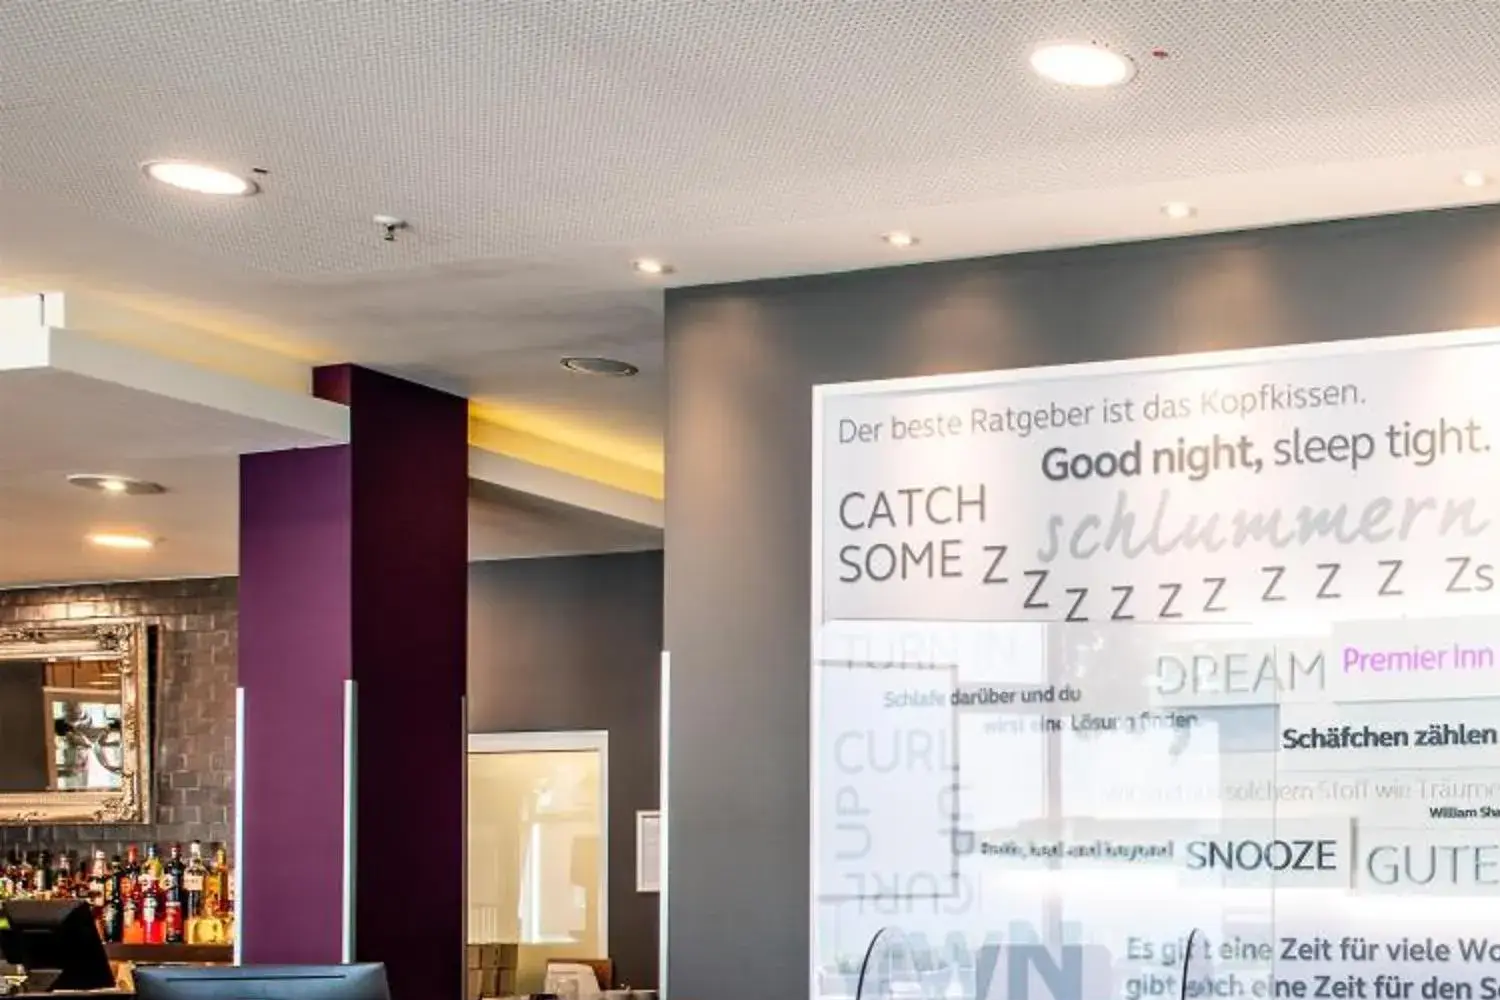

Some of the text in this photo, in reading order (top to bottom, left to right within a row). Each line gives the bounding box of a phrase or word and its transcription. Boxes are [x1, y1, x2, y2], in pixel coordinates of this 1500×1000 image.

[838, 381, 1367, 444] Der beste Ratgeber ist das Kopfkissen.
[1041, 417, 1491, 482] Good night, sleep tight.
[838, 484, 986, 530] CATCH
[1036, 488, 1491, 565] schlummern
[838, 540, 963, 583] SOME
[1343, 643, 1494, 674] Premier Inn
[951, 685, 1017, 707] darüber
[1020, 684, 1055, 704] und
[1058, 684, 1082, 703] du
[834, 728, 958, 776] CURL
[1283, 722, 1498, 750] Schäfchen zählen
[1430, 806, 1478, 819] William
[1187, 839, 1338, 871] SNOOZE
[1367, 844, 1500, 886] GUTE
[1127, 937, 1153, 961] Es
[1218, 936, 1273, 961] eine
[1279, 936, 1332, 961] Zeit
[1340, 936, 1379, 962] für
[1386, 937, 1451, 962] viele
[1252, 974, 1307, 1000] eine
[1313, 975, 1366, 1000] Zeit
[1374, 974, 1414, 1000] für
[1421, 976, 1473, 1000] den
